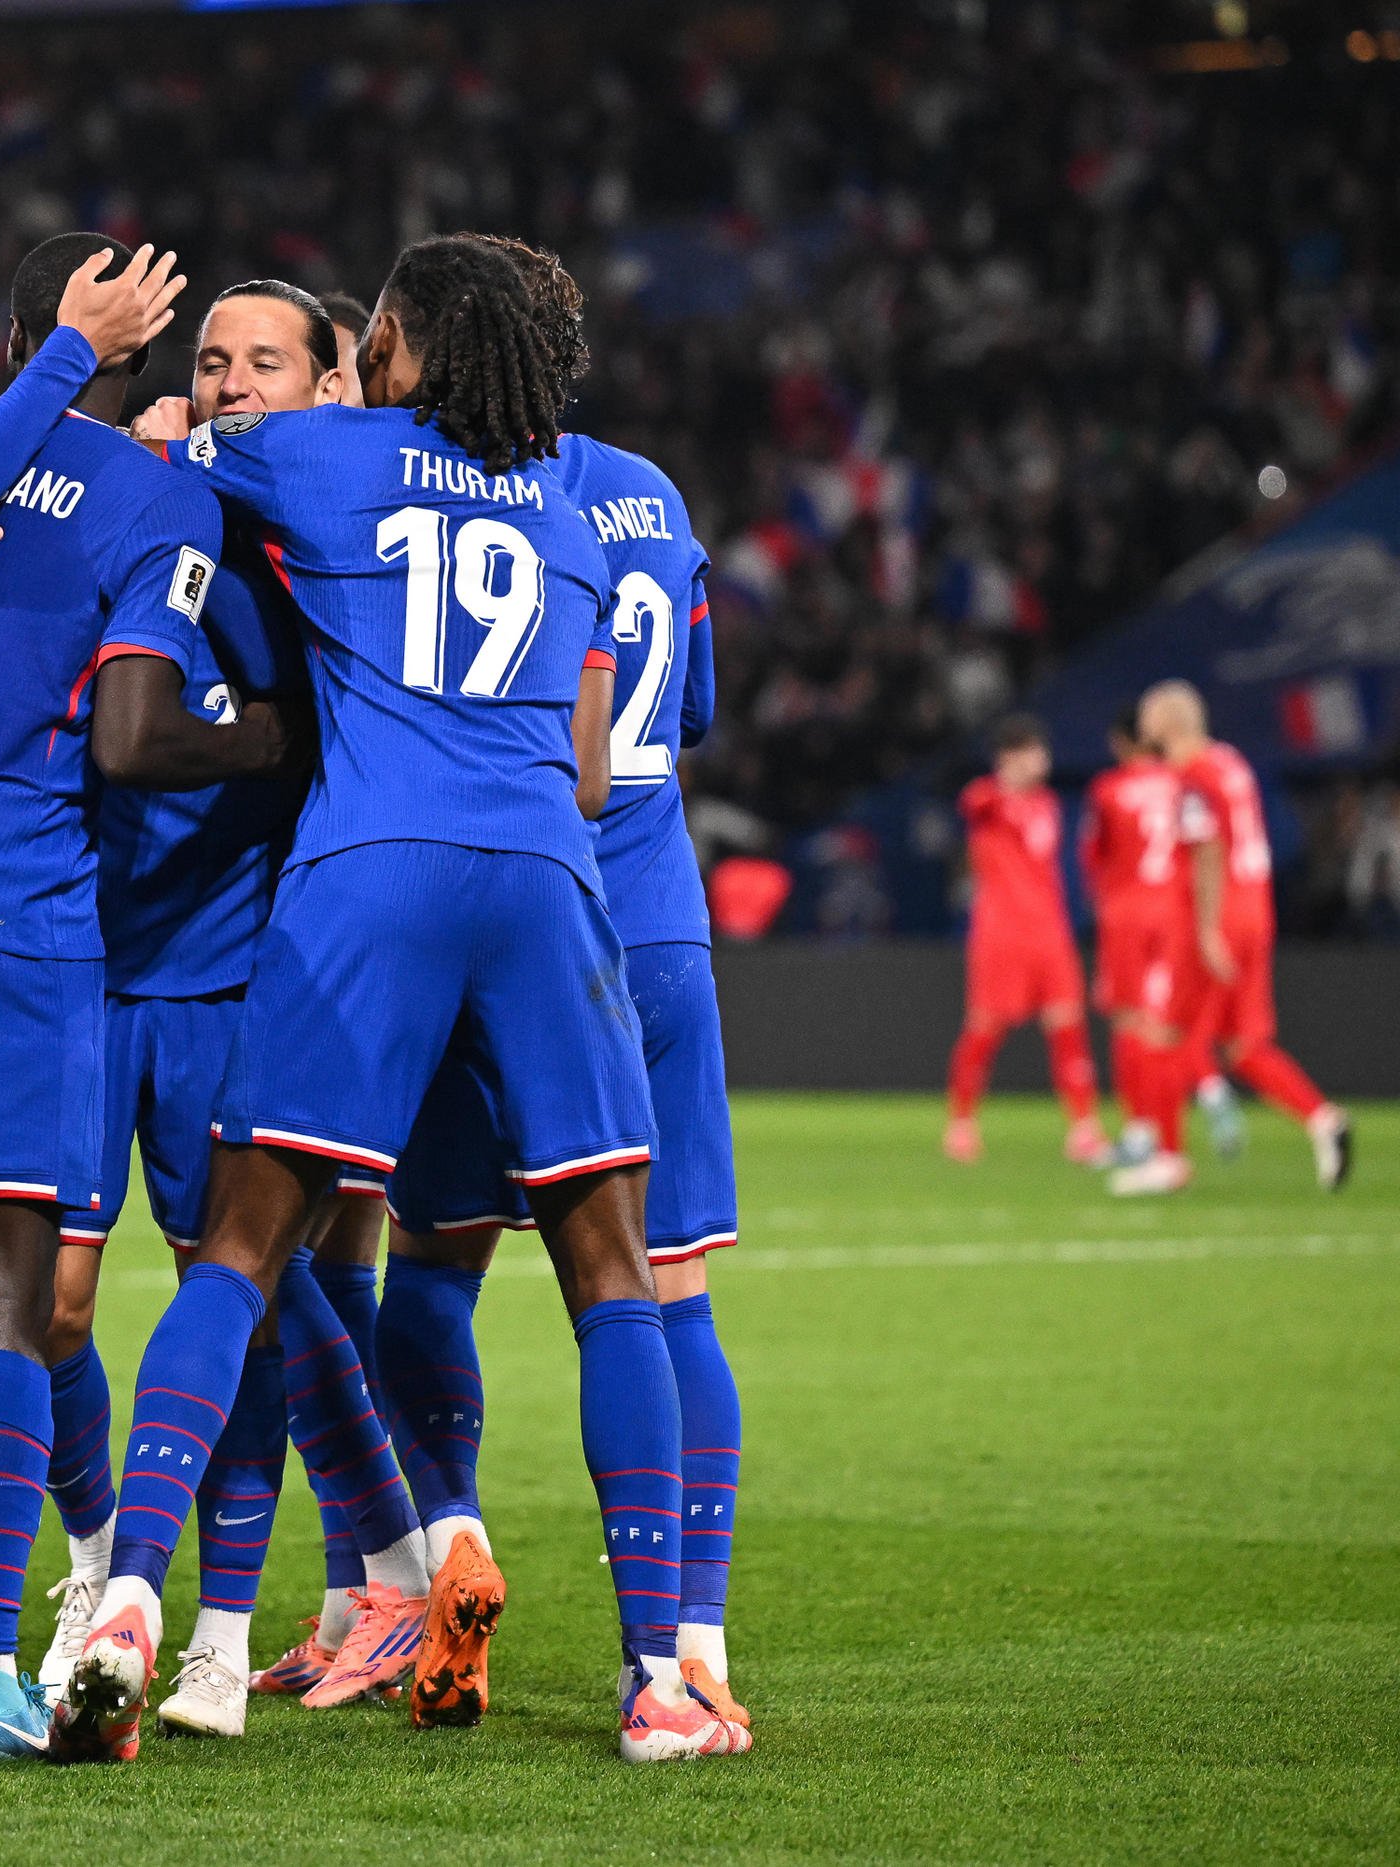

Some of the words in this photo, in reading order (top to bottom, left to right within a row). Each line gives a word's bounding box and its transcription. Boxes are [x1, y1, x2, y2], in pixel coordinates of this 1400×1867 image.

[399, 447, 544, 512] THURAM
[577, 497, 673, 545] ANDEZ
[376, 506, 546, 699] 19
